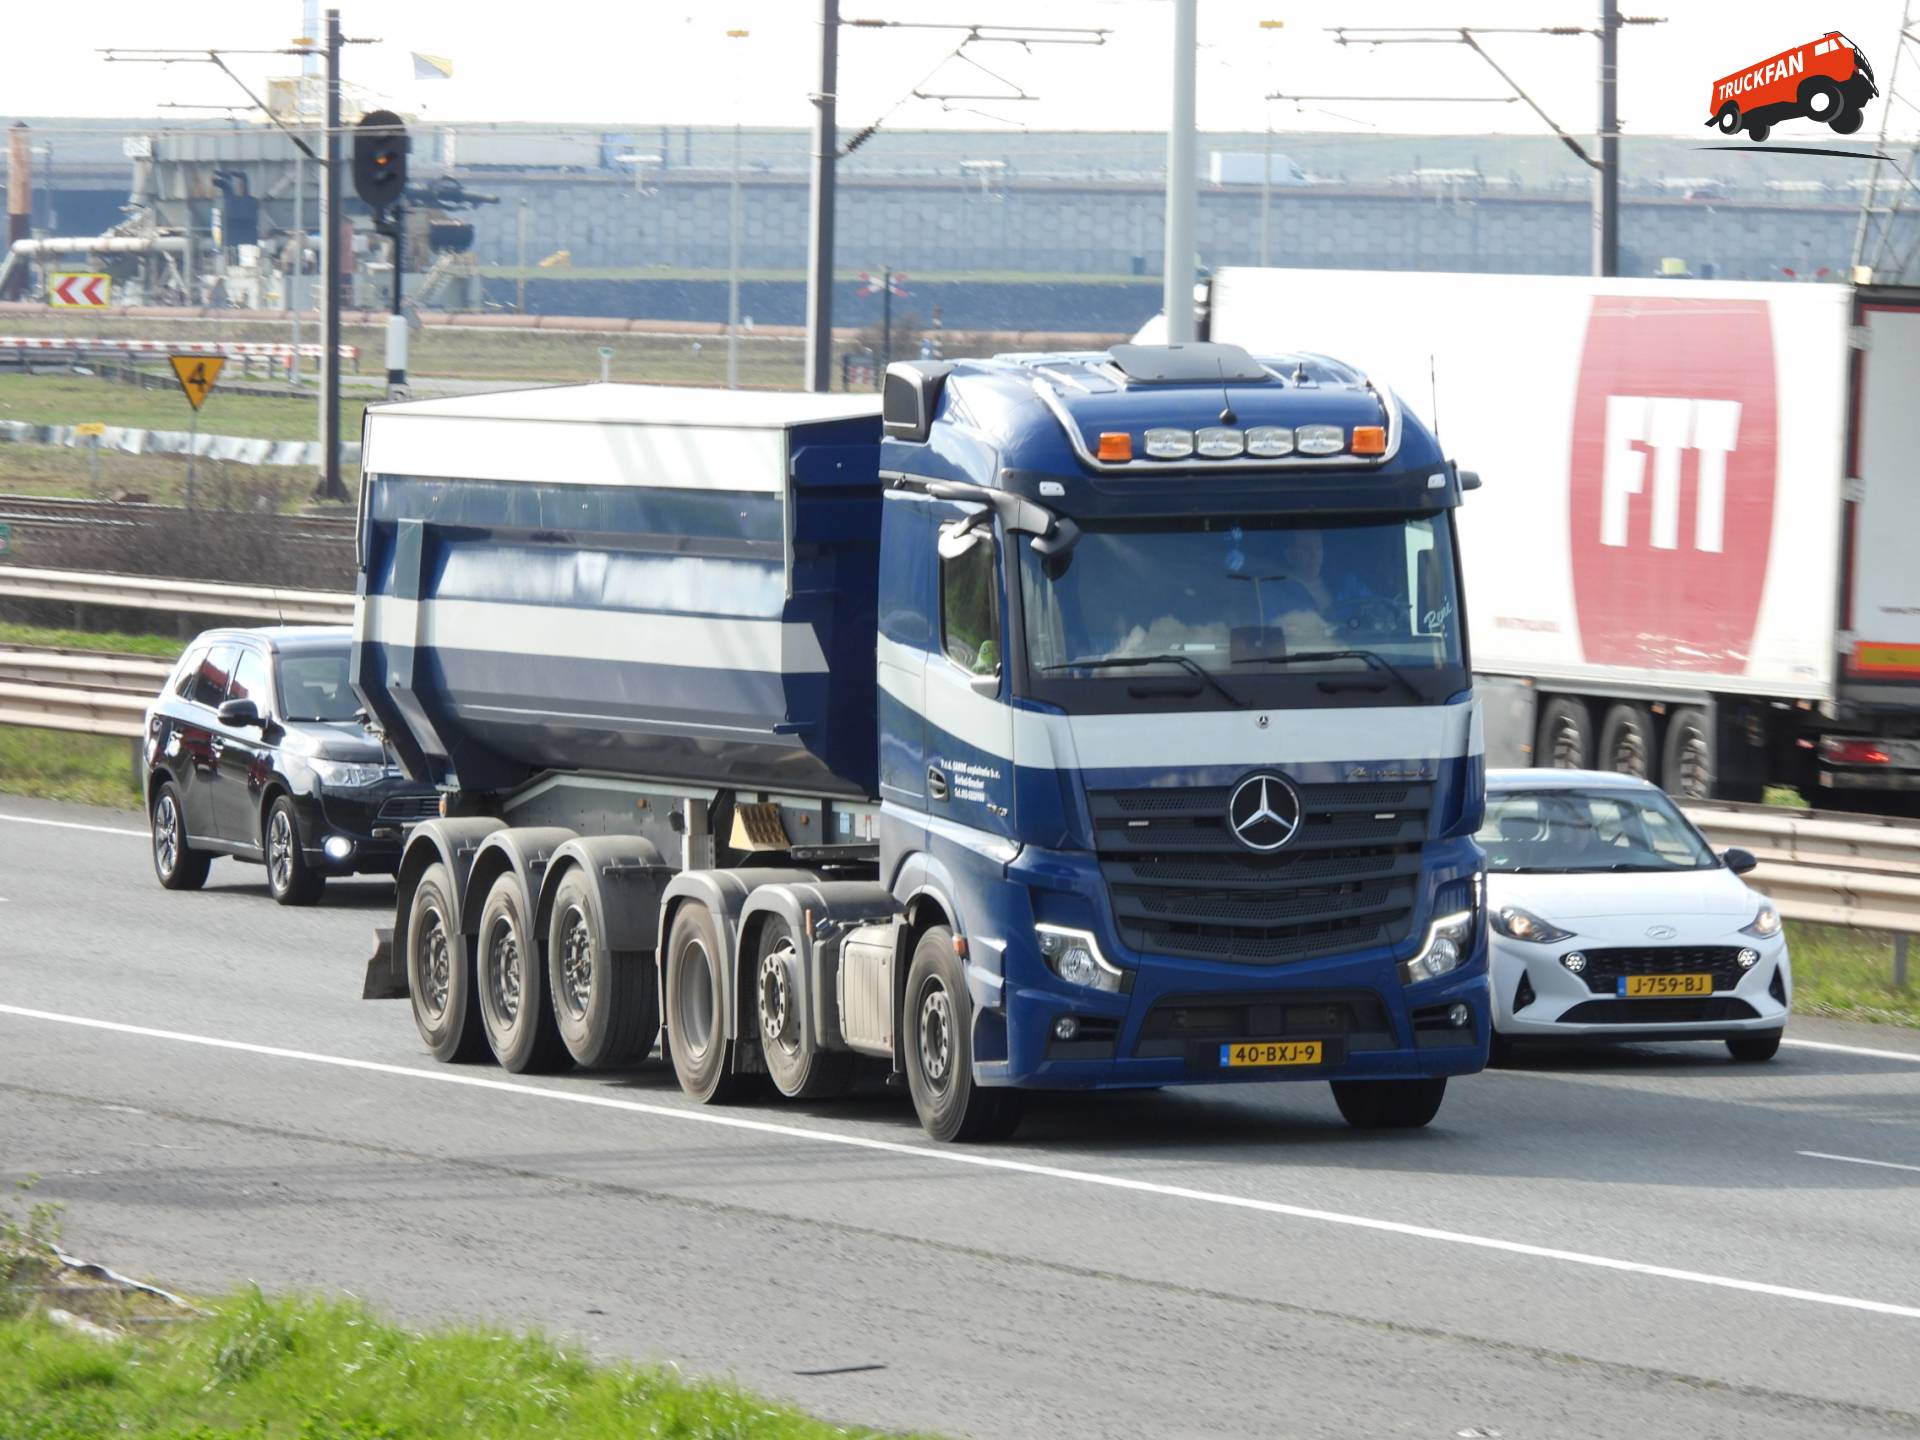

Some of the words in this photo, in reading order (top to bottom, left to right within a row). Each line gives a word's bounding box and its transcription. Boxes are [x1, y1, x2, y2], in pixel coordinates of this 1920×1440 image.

[188, 362, 207, 392] 4
[1634, 976, 1704, 993] J-759-BJ
[1235, 1045, 1315, 1062] 40-BXJ-9
